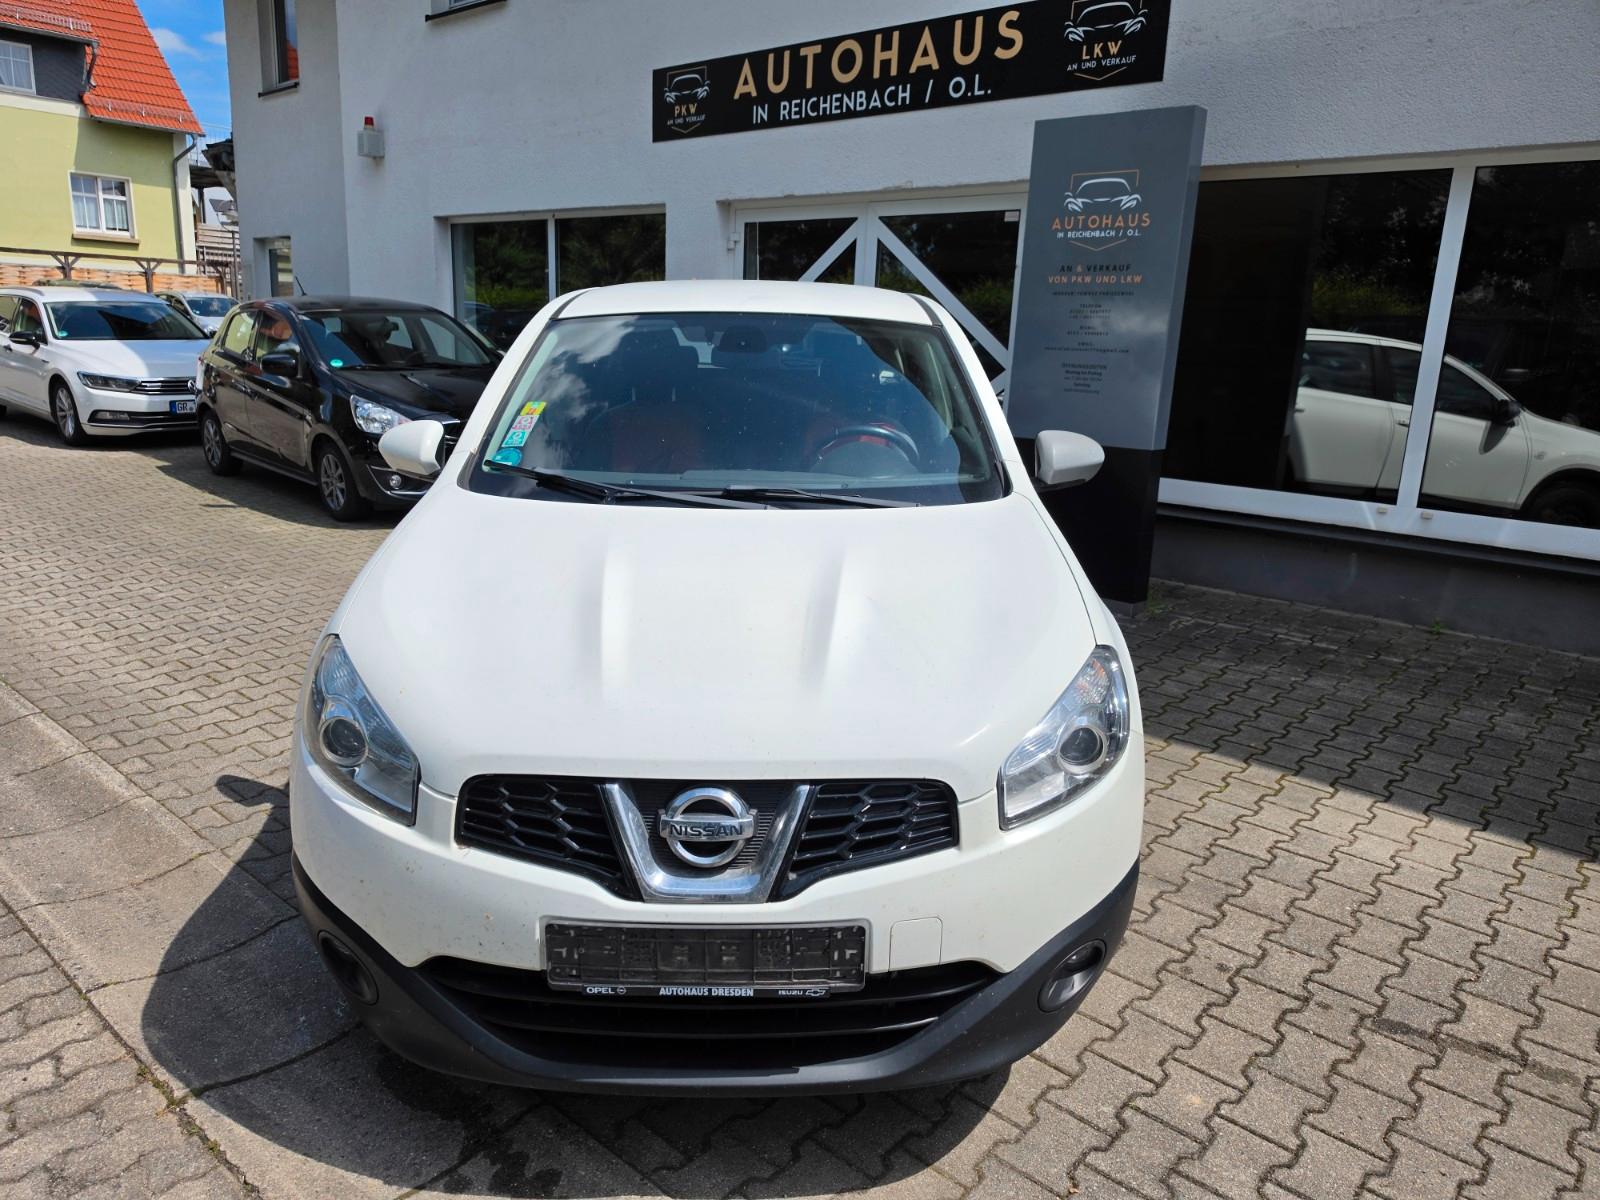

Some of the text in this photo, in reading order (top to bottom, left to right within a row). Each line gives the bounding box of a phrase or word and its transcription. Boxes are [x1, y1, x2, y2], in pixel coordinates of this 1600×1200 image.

[733, 10, 1024, 100] AUTOHAUS
[1082, 40, 1122, 60] LKW
[1066, 54, 1137, 72] AN UND VERKAUF
[752, 74, 992, 125] IN REICHENBACH / O.L.
[674, 103, 698, 117] PKW
[1052, 212, 1151, 231] AUTOHAUS
[1057, 231, 1064, 239] IN
[1067, 229, 1116, 239] REICHENBACH
[1060, 264, 1073, 273] AN
[1086, 263, 1132, 273] VERKAUF
[1048, 274, 1143, 284] VON PKW UND LKW
[177, 402, 188, 412] GR
[669, 822, 743, 837] NISSAN
[586, 986, 616, 994] OPEL
[659, 986, 754, 997] AUTOHAUS DRESDEN
